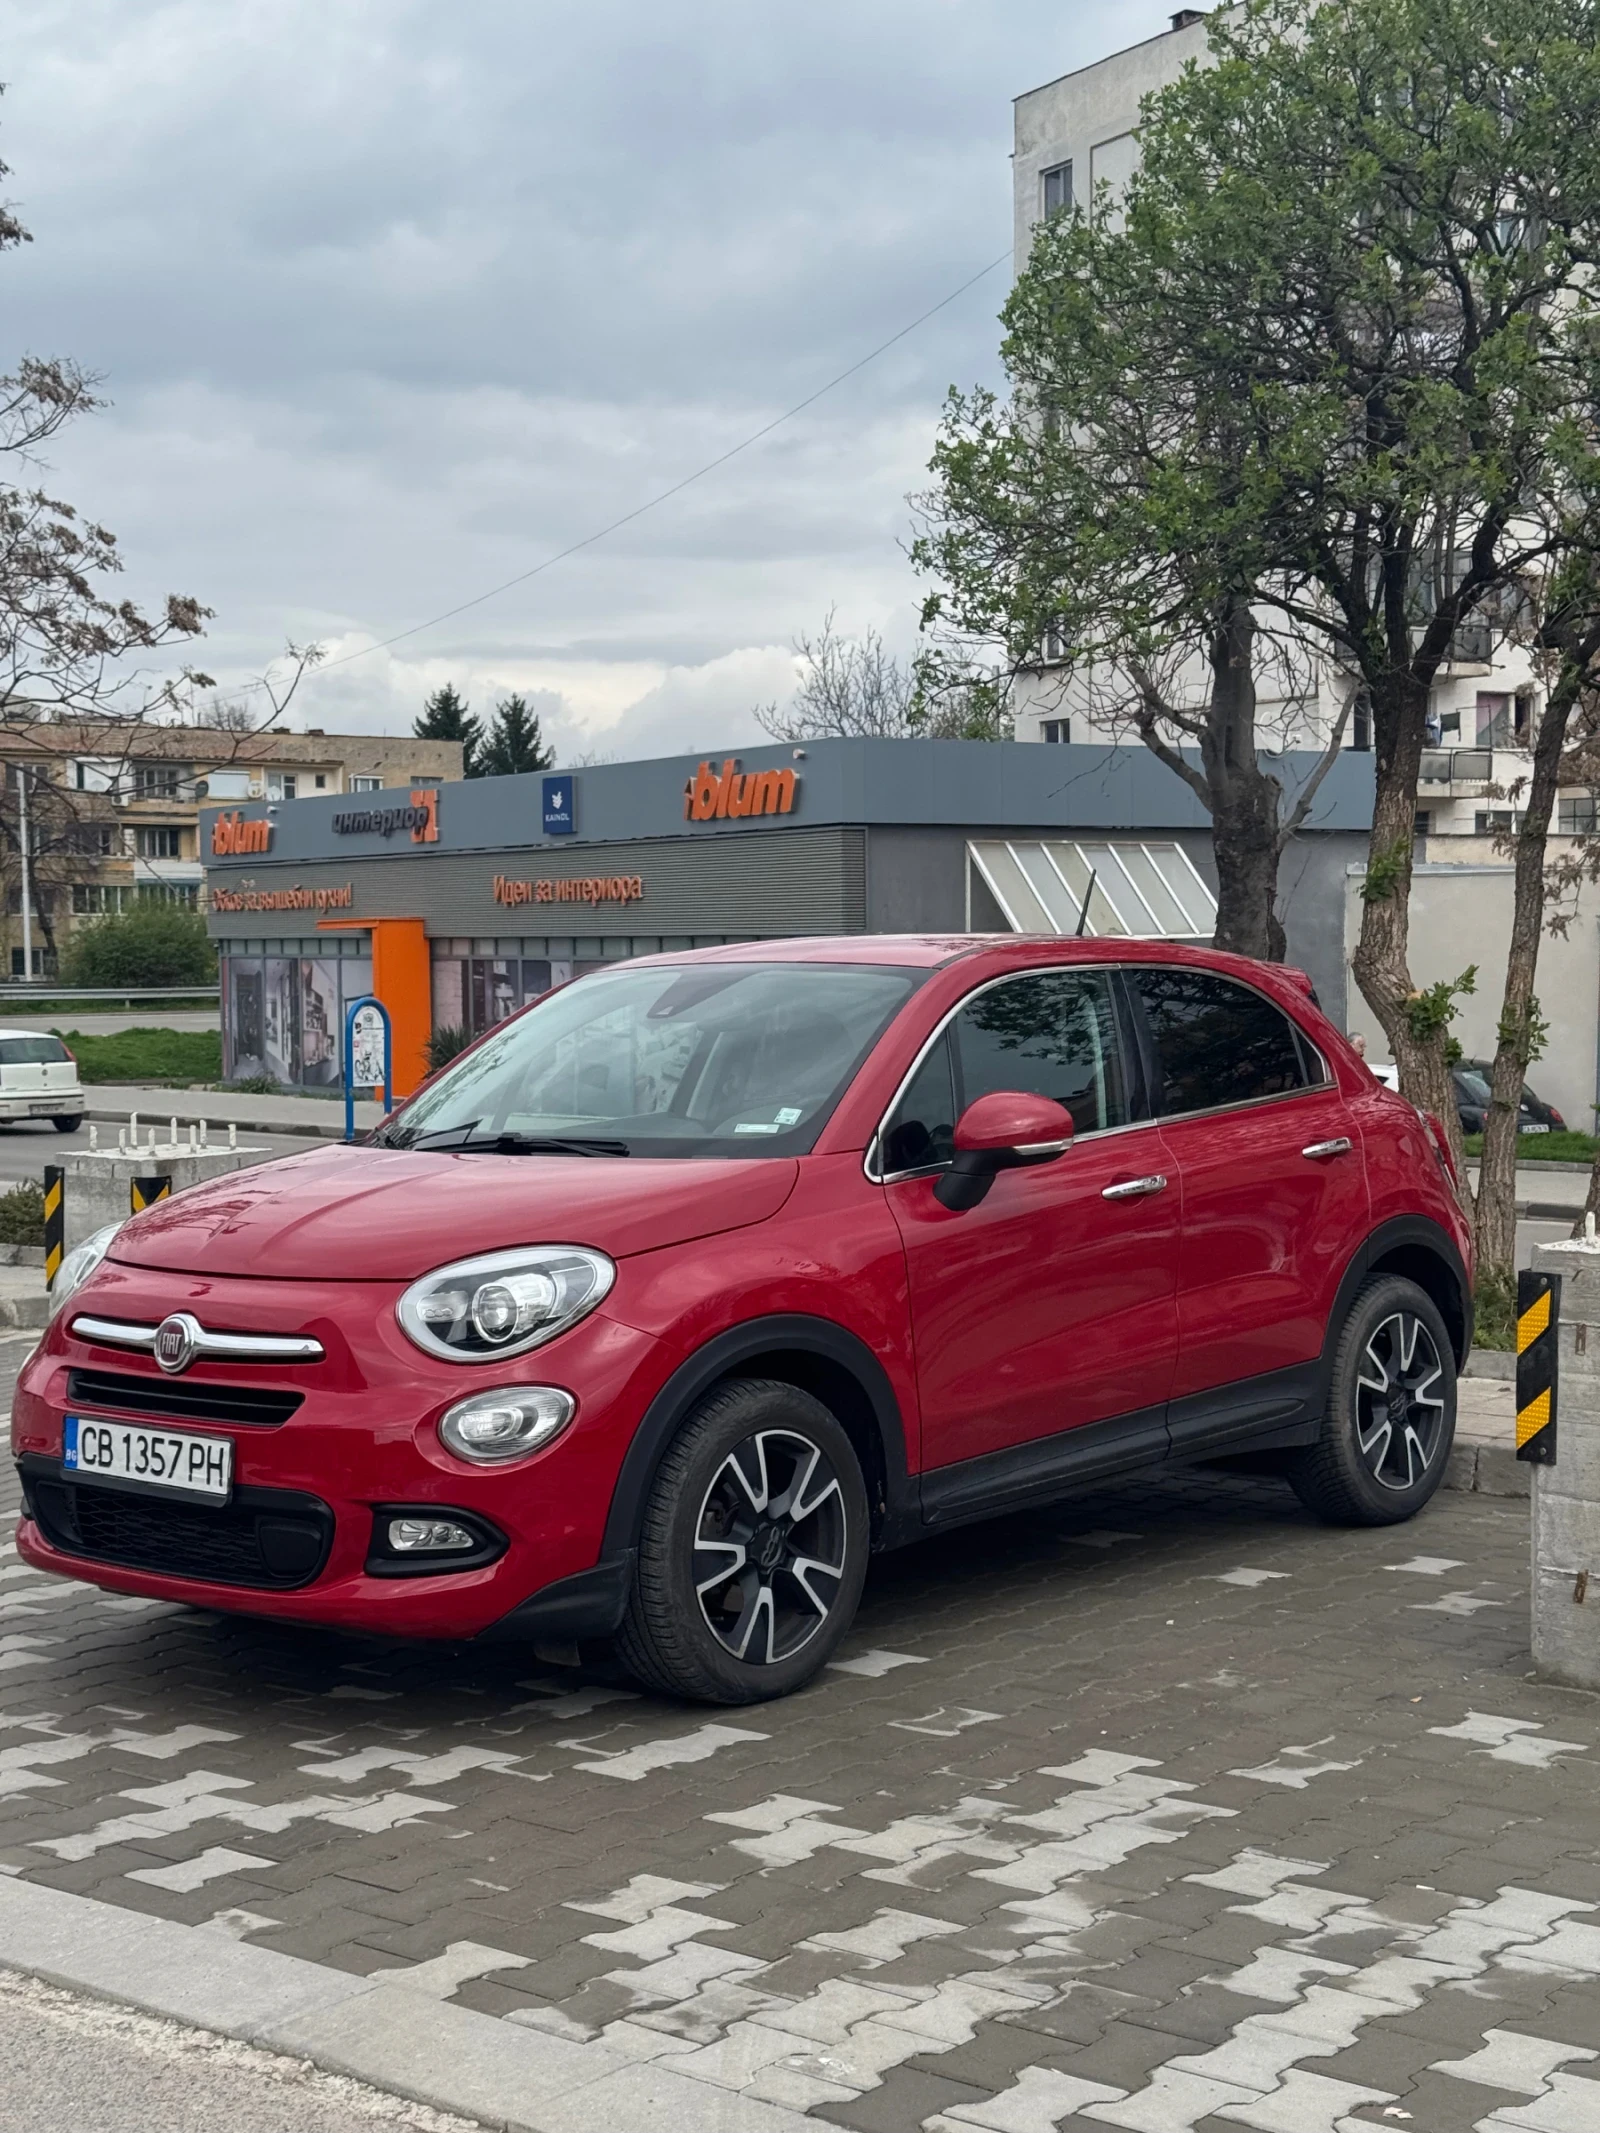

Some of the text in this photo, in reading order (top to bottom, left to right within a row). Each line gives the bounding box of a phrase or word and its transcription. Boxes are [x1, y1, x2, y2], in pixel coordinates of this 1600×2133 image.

[690, 758, 797, 820] blum
[214, 811, 271, 855] blum
[332, 806, 429, 837] интериор
[494, 875, 643, 907] Идеи за интериора
[162, 1333, 182, 1355] FIAT
[65, 1449, 77, 1462] BG
[81, 1426, 224, 1488] CB 1357 PH
